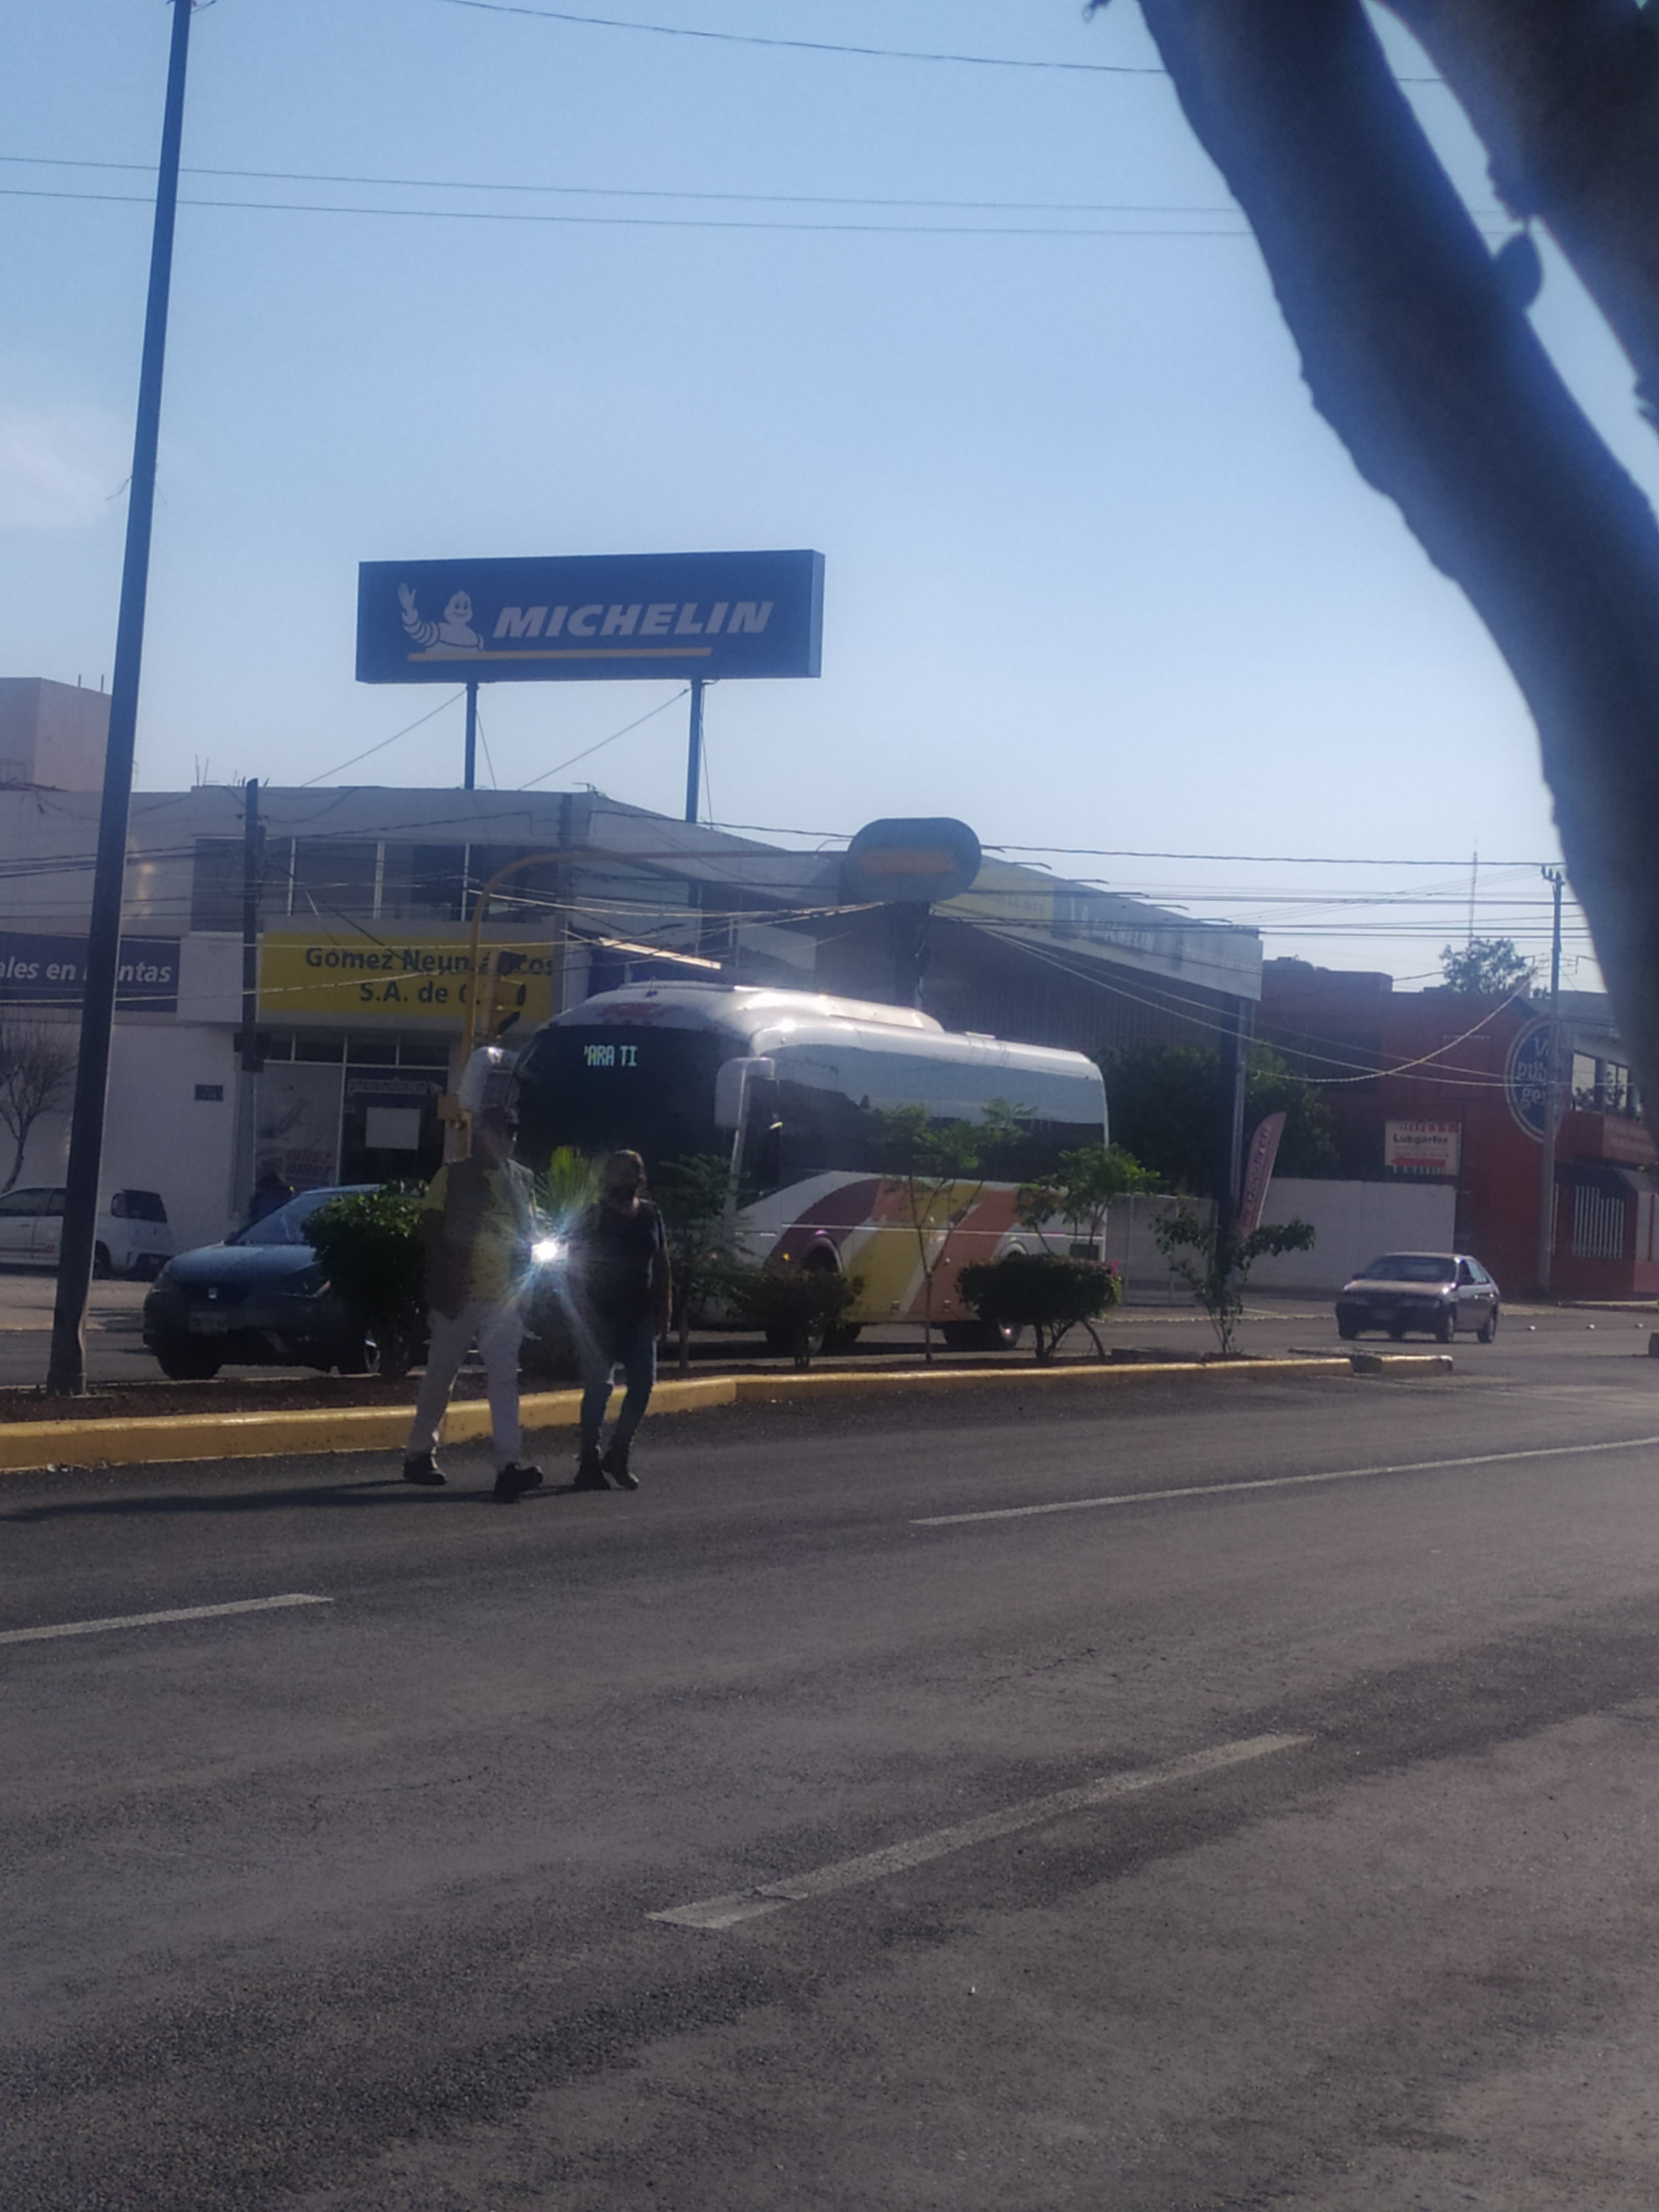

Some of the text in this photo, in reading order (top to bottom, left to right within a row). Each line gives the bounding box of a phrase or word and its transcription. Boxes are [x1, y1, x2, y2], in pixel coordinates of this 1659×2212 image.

[493, 601, 774, 638] MICHELIN
[46, 962, 77, 980] en
[359, 980, 408, 1003] S.A.
[418, 979, 448, 1004] de
[619, 1045, 638, 1067] TI
